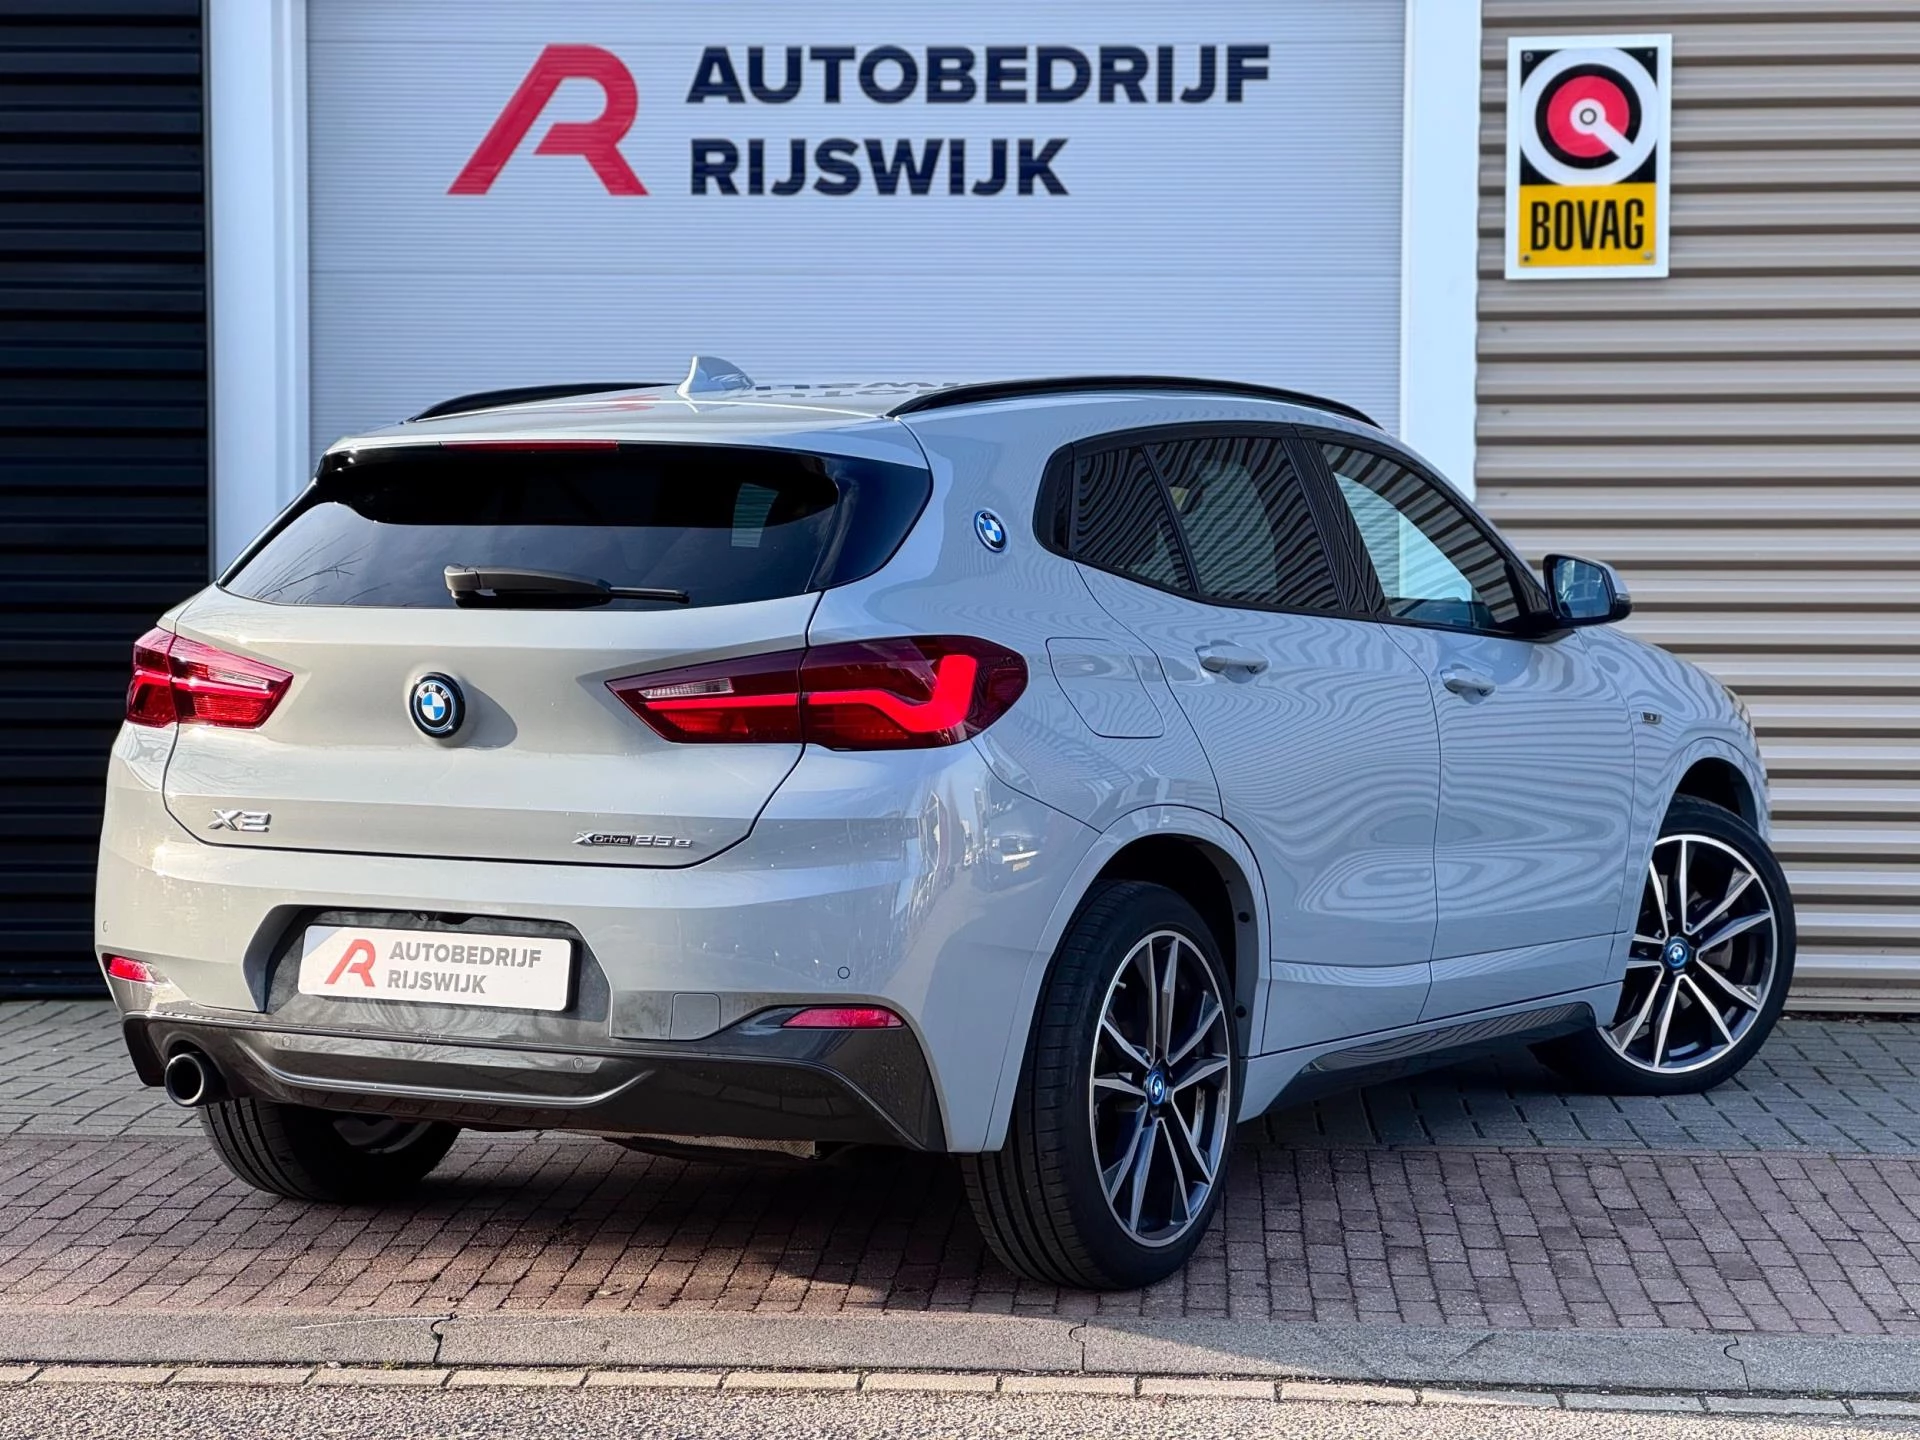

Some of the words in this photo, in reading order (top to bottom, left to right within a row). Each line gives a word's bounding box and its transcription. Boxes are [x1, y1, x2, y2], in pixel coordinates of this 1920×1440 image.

[686, 45, 1271, 104] AUTOBEDRIJF
[690, 138, 1069, 195] RIJSWIJK
[1530, 198, 1645, 251] BOVAG
[208, 808, 272, 833] X2
[388, 941, 542, 968] AUTOBEDRIJF
[386, 969, 487, 994] RIJSWIJK
